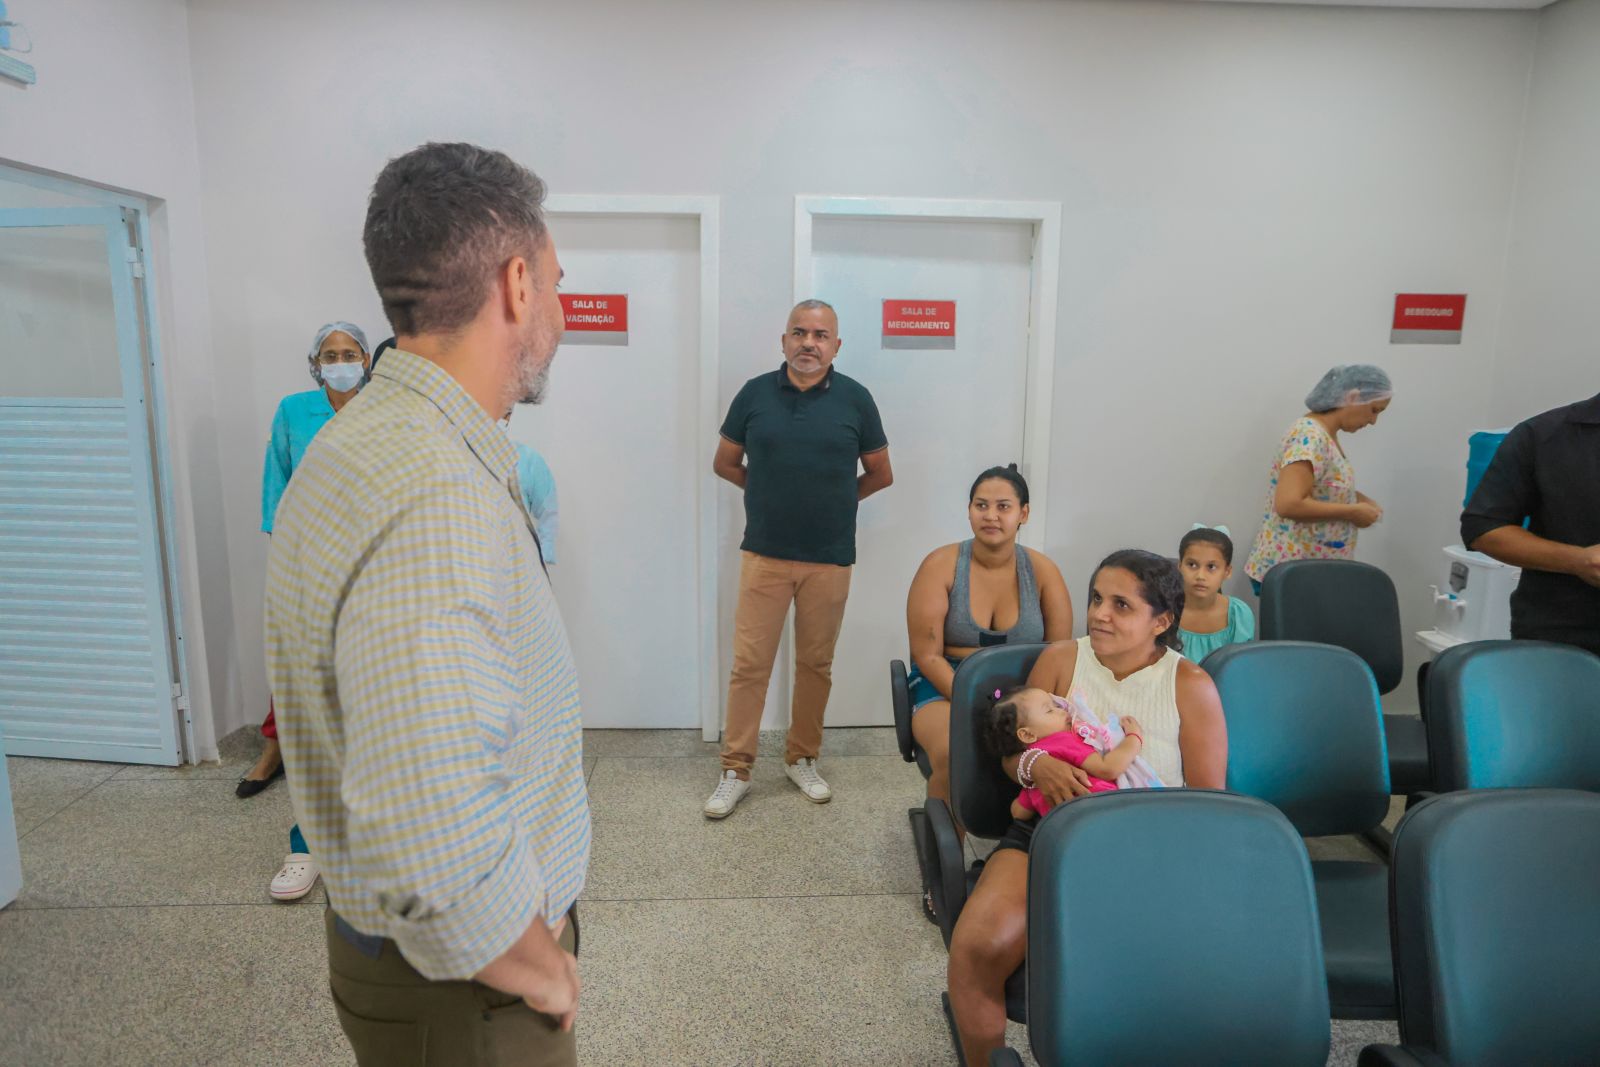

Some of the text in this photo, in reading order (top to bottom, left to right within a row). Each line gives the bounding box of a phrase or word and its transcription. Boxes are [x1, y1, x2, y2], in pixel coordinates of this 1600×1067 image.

[572, 300, 608, 309] SALA DE
[901, 307, 937, 316] SALA DE
[1404, 307, 1454, 317] BEBEDOURO
[565, 313, 615, 326] VACINAÇÃO
[887, 320, 950, 330] MEDICAMENTO
